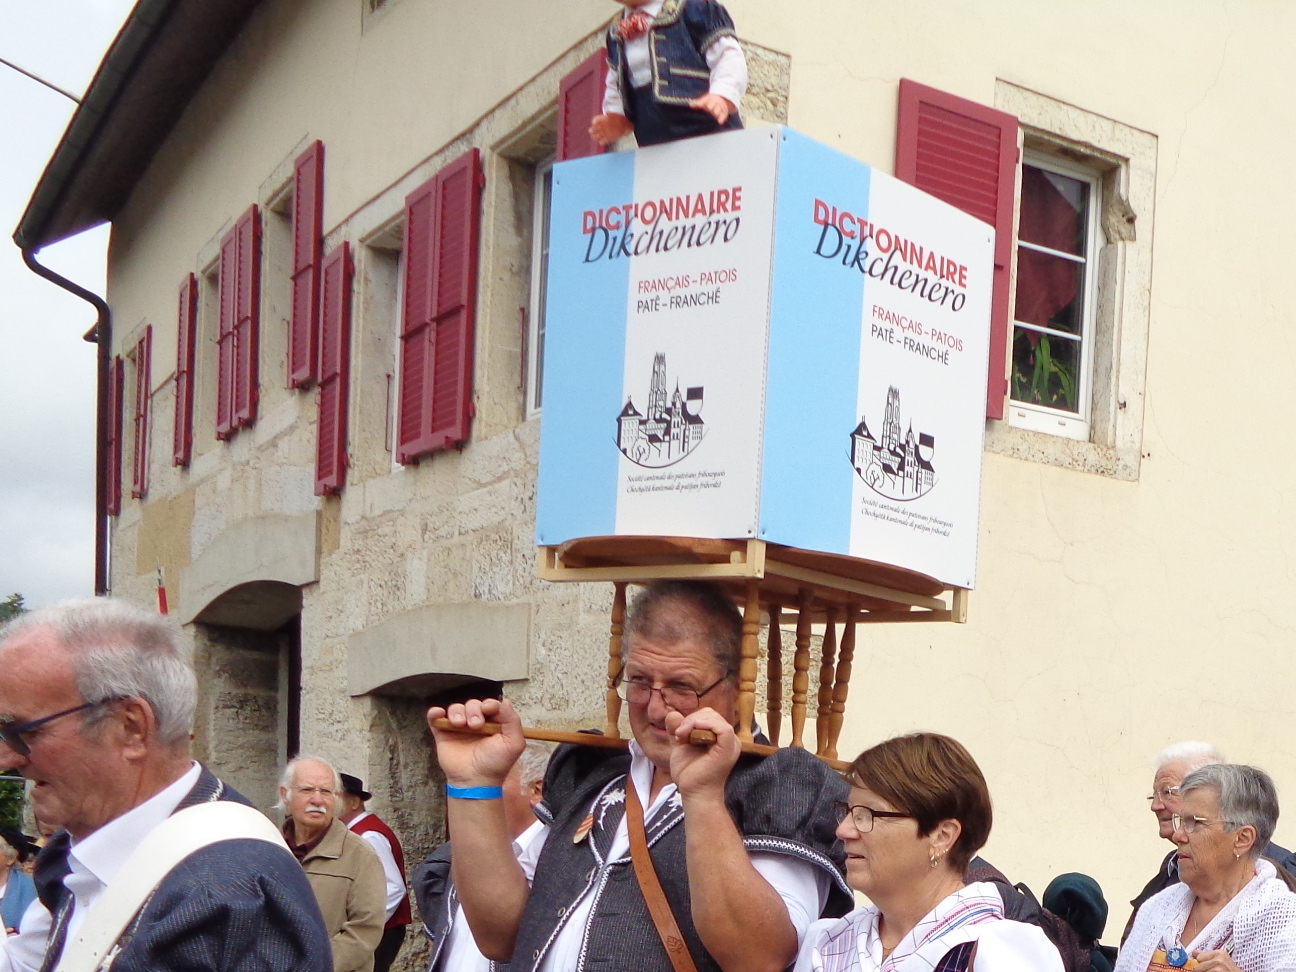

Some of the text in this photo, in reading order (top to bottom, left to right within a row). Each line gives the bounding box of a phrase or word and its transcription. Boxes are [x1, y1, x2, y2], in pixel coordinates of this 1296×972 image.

[582, 186, 742, 235] DICTIONNAIRE
[813, 198, 968, 289] DICTIONNAIRE
[637, 294, 660, 313] PATÊ
[670, 287, 721, 310] FRANCHÉ
[638, 274, 690, 294] FRANÇAIS
[700, 268, 738, 286] PATOIS
[871, 323, 894, 344] PATÊ
[903, 336, 949, 366] FRANCHÉ
[872, 304, 923, 336] FRANÇAIS
[931, 328, 964, 351] PATOIS
